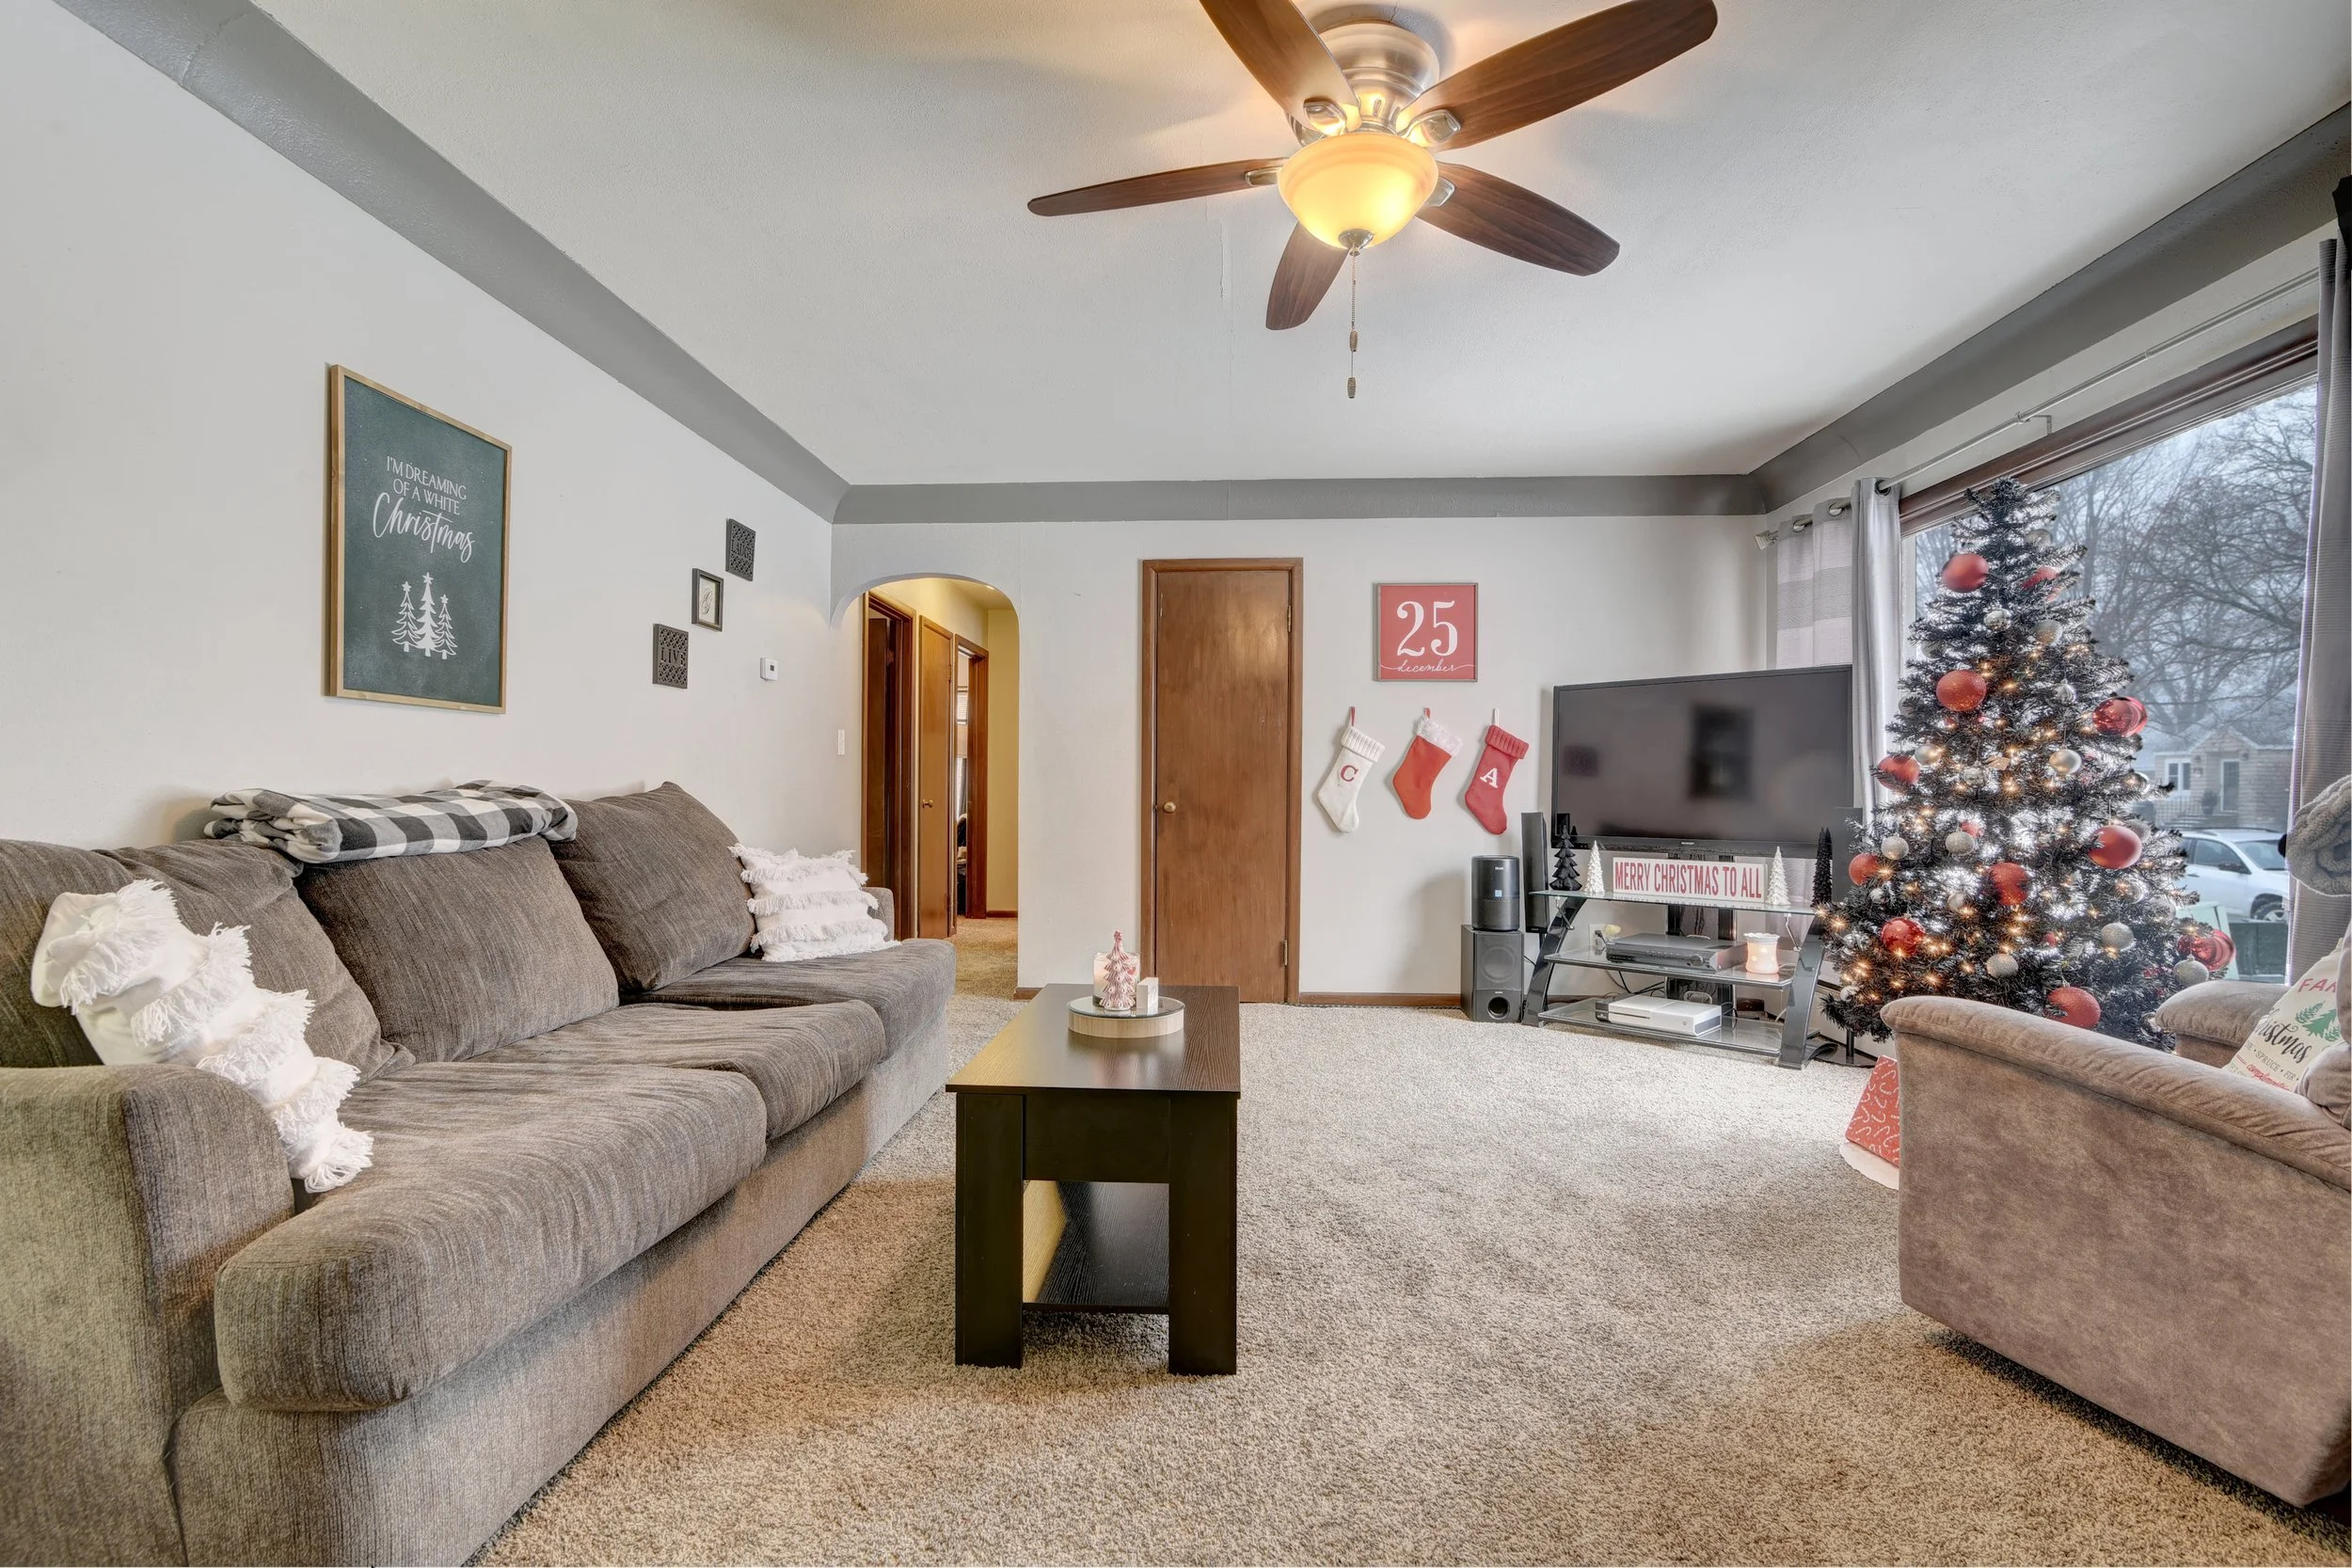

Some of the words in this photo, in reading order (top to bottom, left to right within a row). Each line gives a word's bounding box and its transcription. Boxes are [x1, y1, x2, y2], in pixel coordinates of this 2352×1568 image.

[387, 456, 403, 477] I'M
[405, 464, 467, 499] DREAMING
[393, 478, 410, 497] OF
[411, 485, 421, 501] A
[423, 489, 460, 515] WHITE
[373, 492, 476, 563] Christmas
[1396, 600, 1458, 657] 25
[660, 646, 687, 667] LIVE
[1396, 657, 1458, 673] december
[1340, 764, 1359, 783] C
[1479, 767, 1499, 788] A
[1614, 862, 1651, 892] MERRY
[1654, 863, 1720, 896] CHRISTMAS
[1723, 865, 1738, 897] TO
[1740, 866, 1762, 899] ALL
[2255, 1050, 2280, 1073] SPRUCE
[2282, 1069, 2296, 1082] FIR
